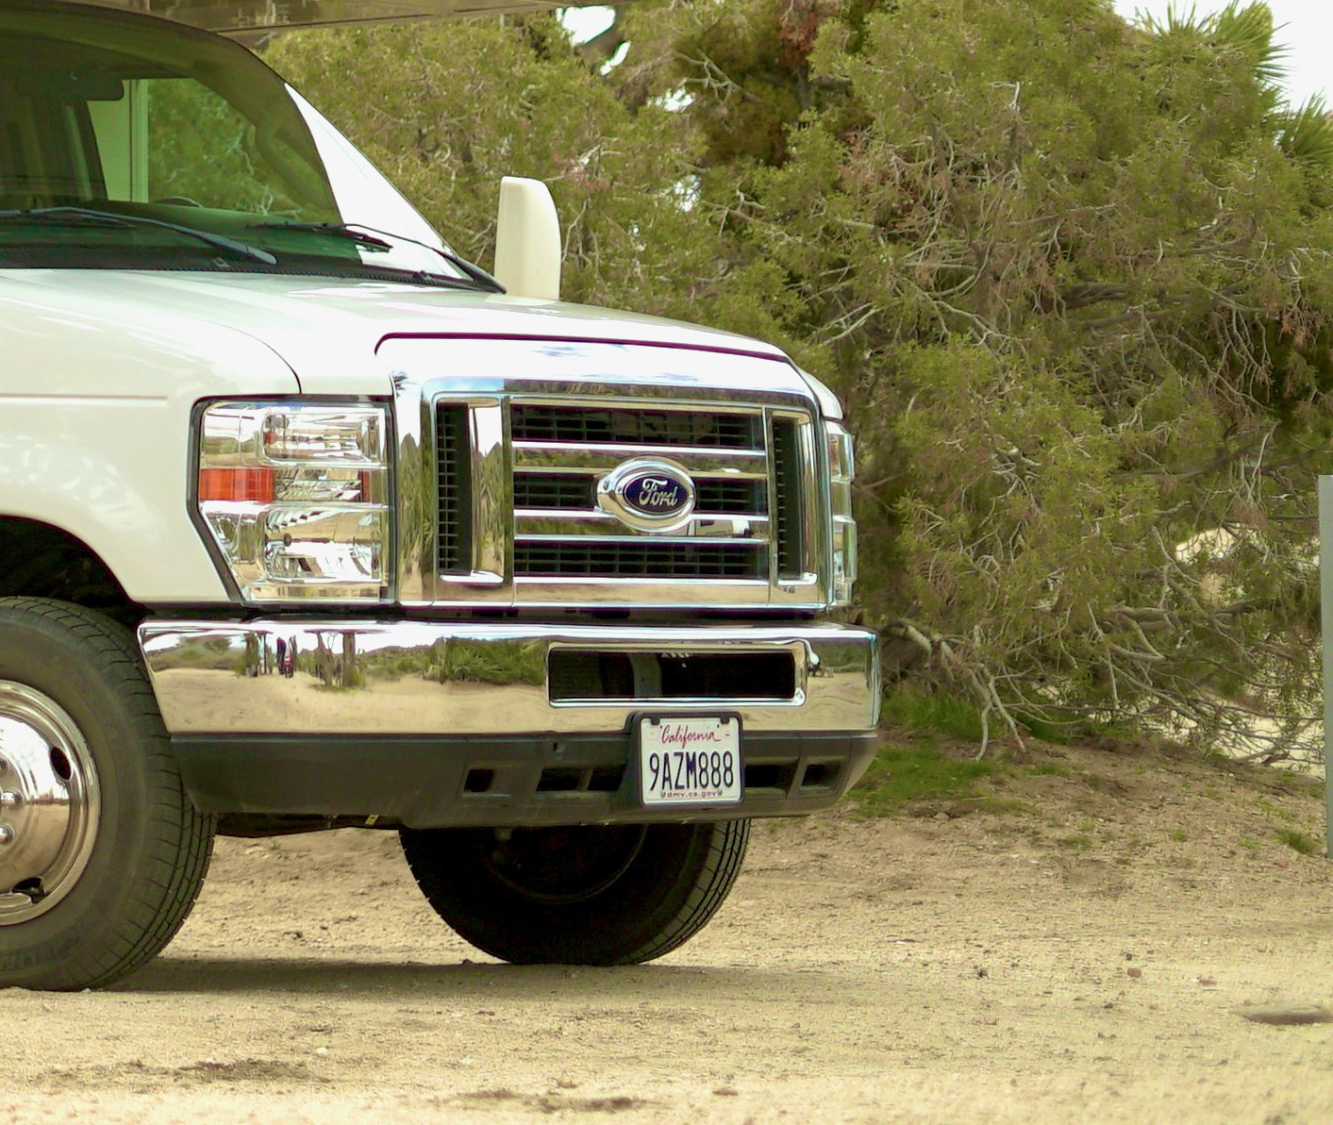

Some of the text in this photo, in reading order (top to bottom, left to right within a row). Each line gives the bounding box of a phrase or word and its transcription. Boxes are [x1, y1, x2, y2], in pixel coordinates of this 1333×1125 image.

[638, 478, 679, 507] Ford
[661, 724, 722, 749] California
[649, 750, 734, 791] 9AZM888
[666, 790, 718, 798] dmv.ca.gov
